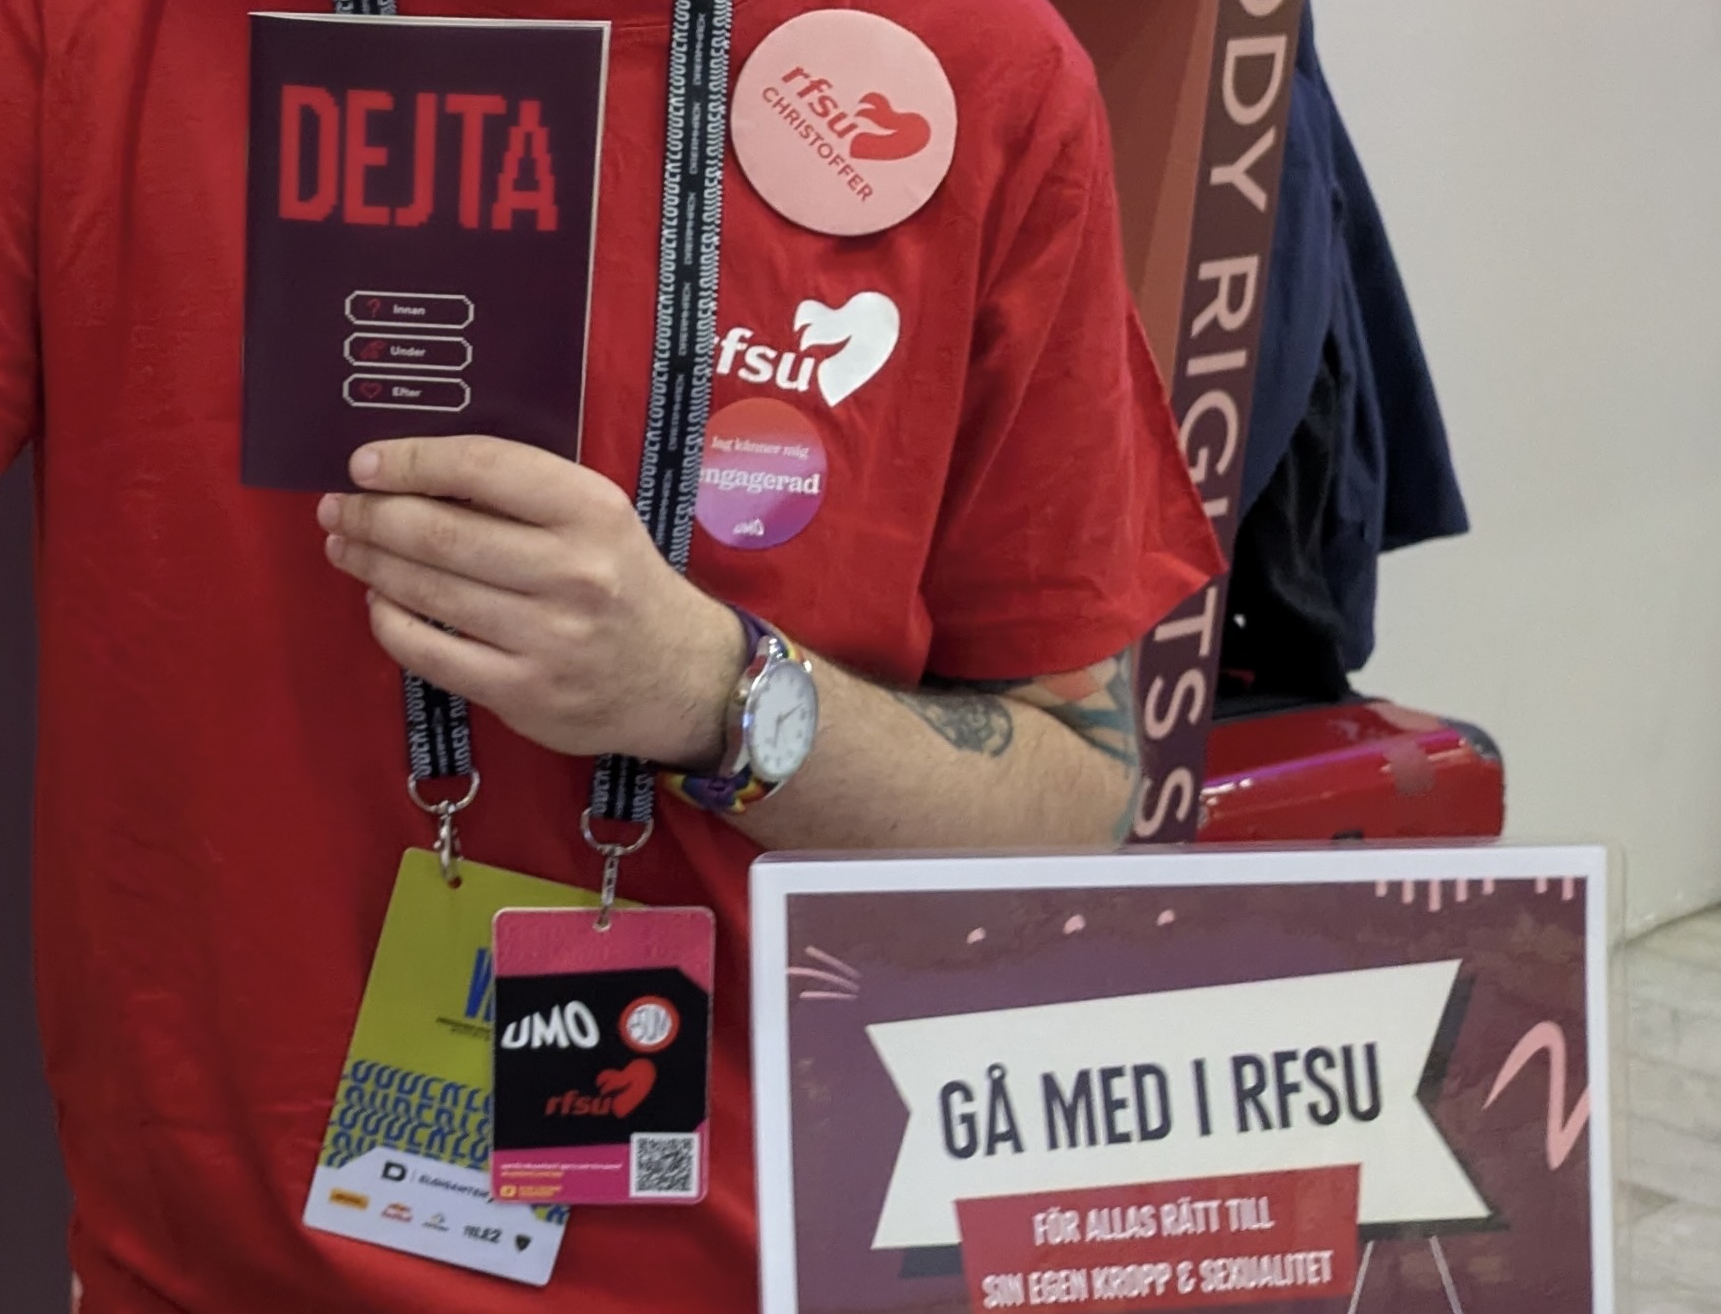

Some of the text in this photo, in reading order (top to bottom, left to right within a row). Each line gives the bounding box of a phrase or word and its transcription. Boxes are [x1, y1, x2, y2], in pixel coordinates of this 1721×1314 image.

[781, 65, 860, 140] rfsu
[278, 83, 559, 232] DEJTA
[761, 85, 875, 203] CHRISTOFFER
[392, 303, 427, 317] Innan
[389, 345, 428, 358] Under
[713, 326, 816, 393] fsu
[500, 1000, 600, 1050] UMO
[544, 1089, 614, 1118] rfsu
[940, 1042, 1383, 1160] GÅ MED I RFSU
[1033, 1196, 1276, 1246] FÖR ALLAS RÄTT TILL
[981, 1249, 1335, 1310] SIN EGEN KROPP & SEXUALITET
